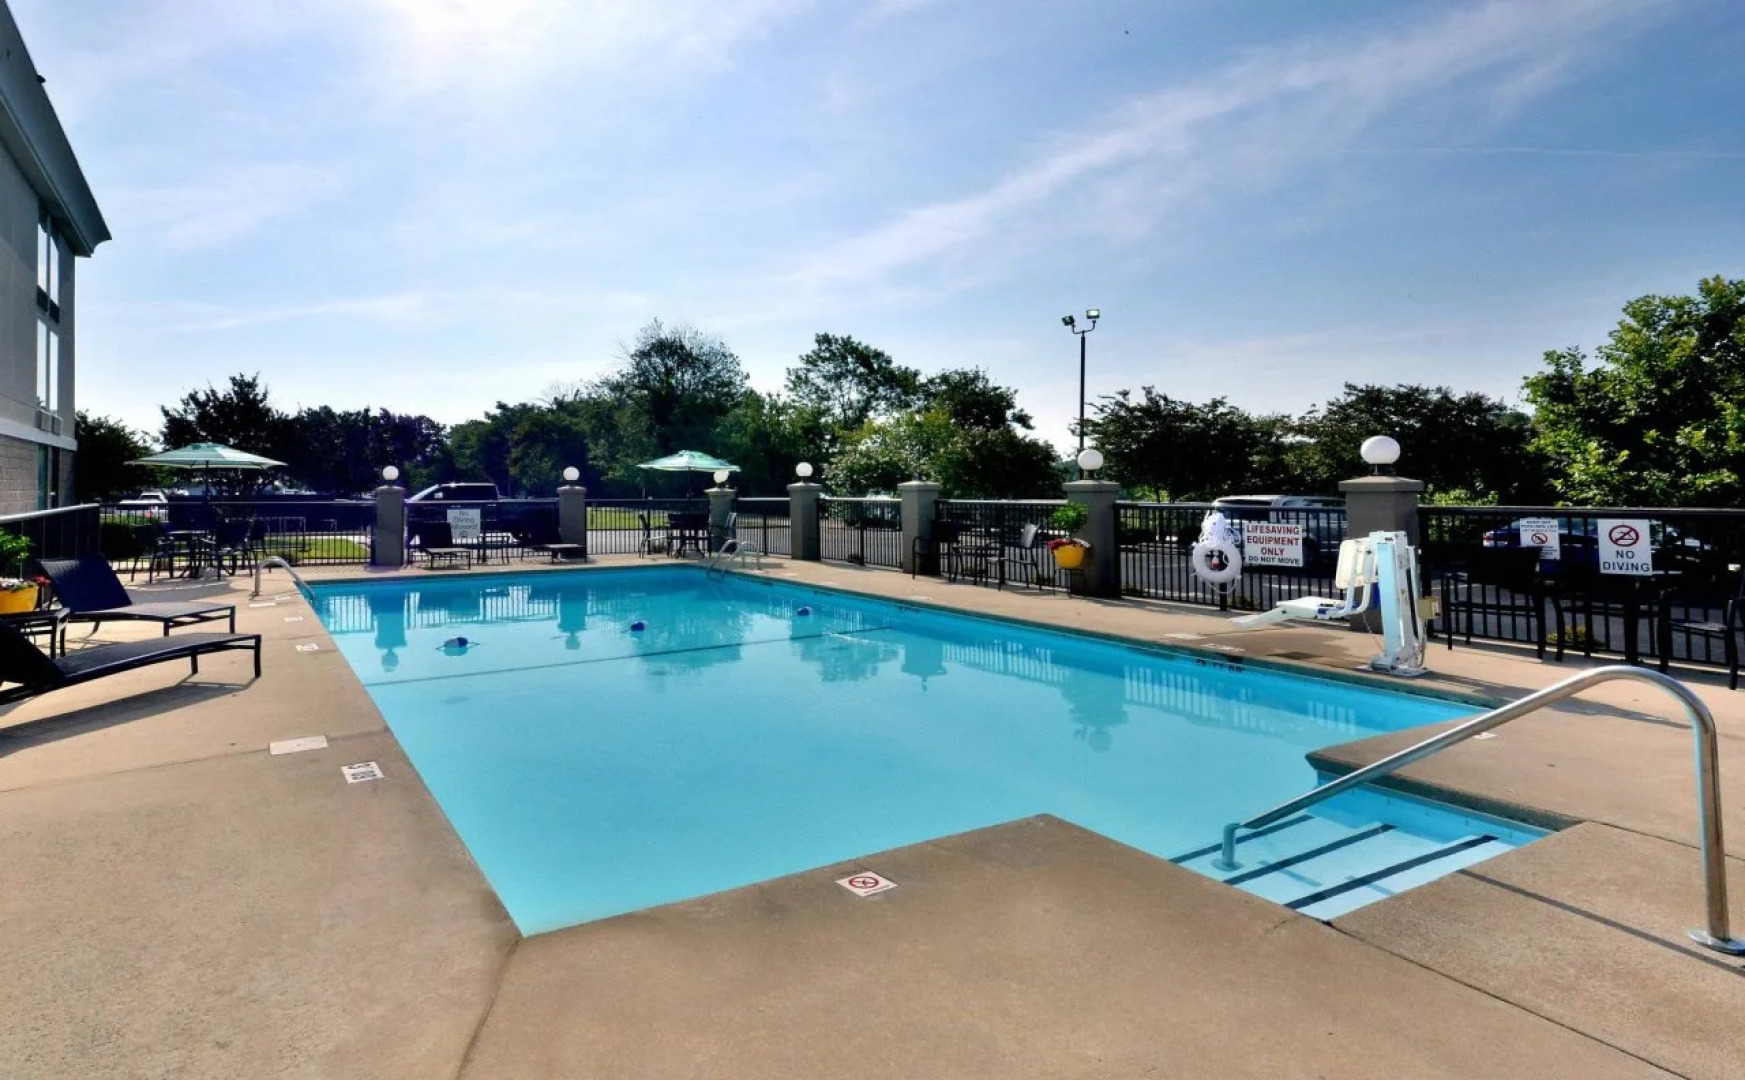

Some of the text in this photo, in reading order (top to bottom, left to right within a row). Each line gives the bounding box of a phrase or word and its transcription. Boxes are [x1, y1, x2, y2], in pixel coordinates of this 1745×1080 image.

[1247, 525, 1299, 534] LIFESAVING
[1247, 536, 1299, 546] EQUIPMENT
[1260, 546, 1285, 556] ONLY
[1616, 550, 1635, 559] NO
[1603, 561, 1650, 572] DIVING
